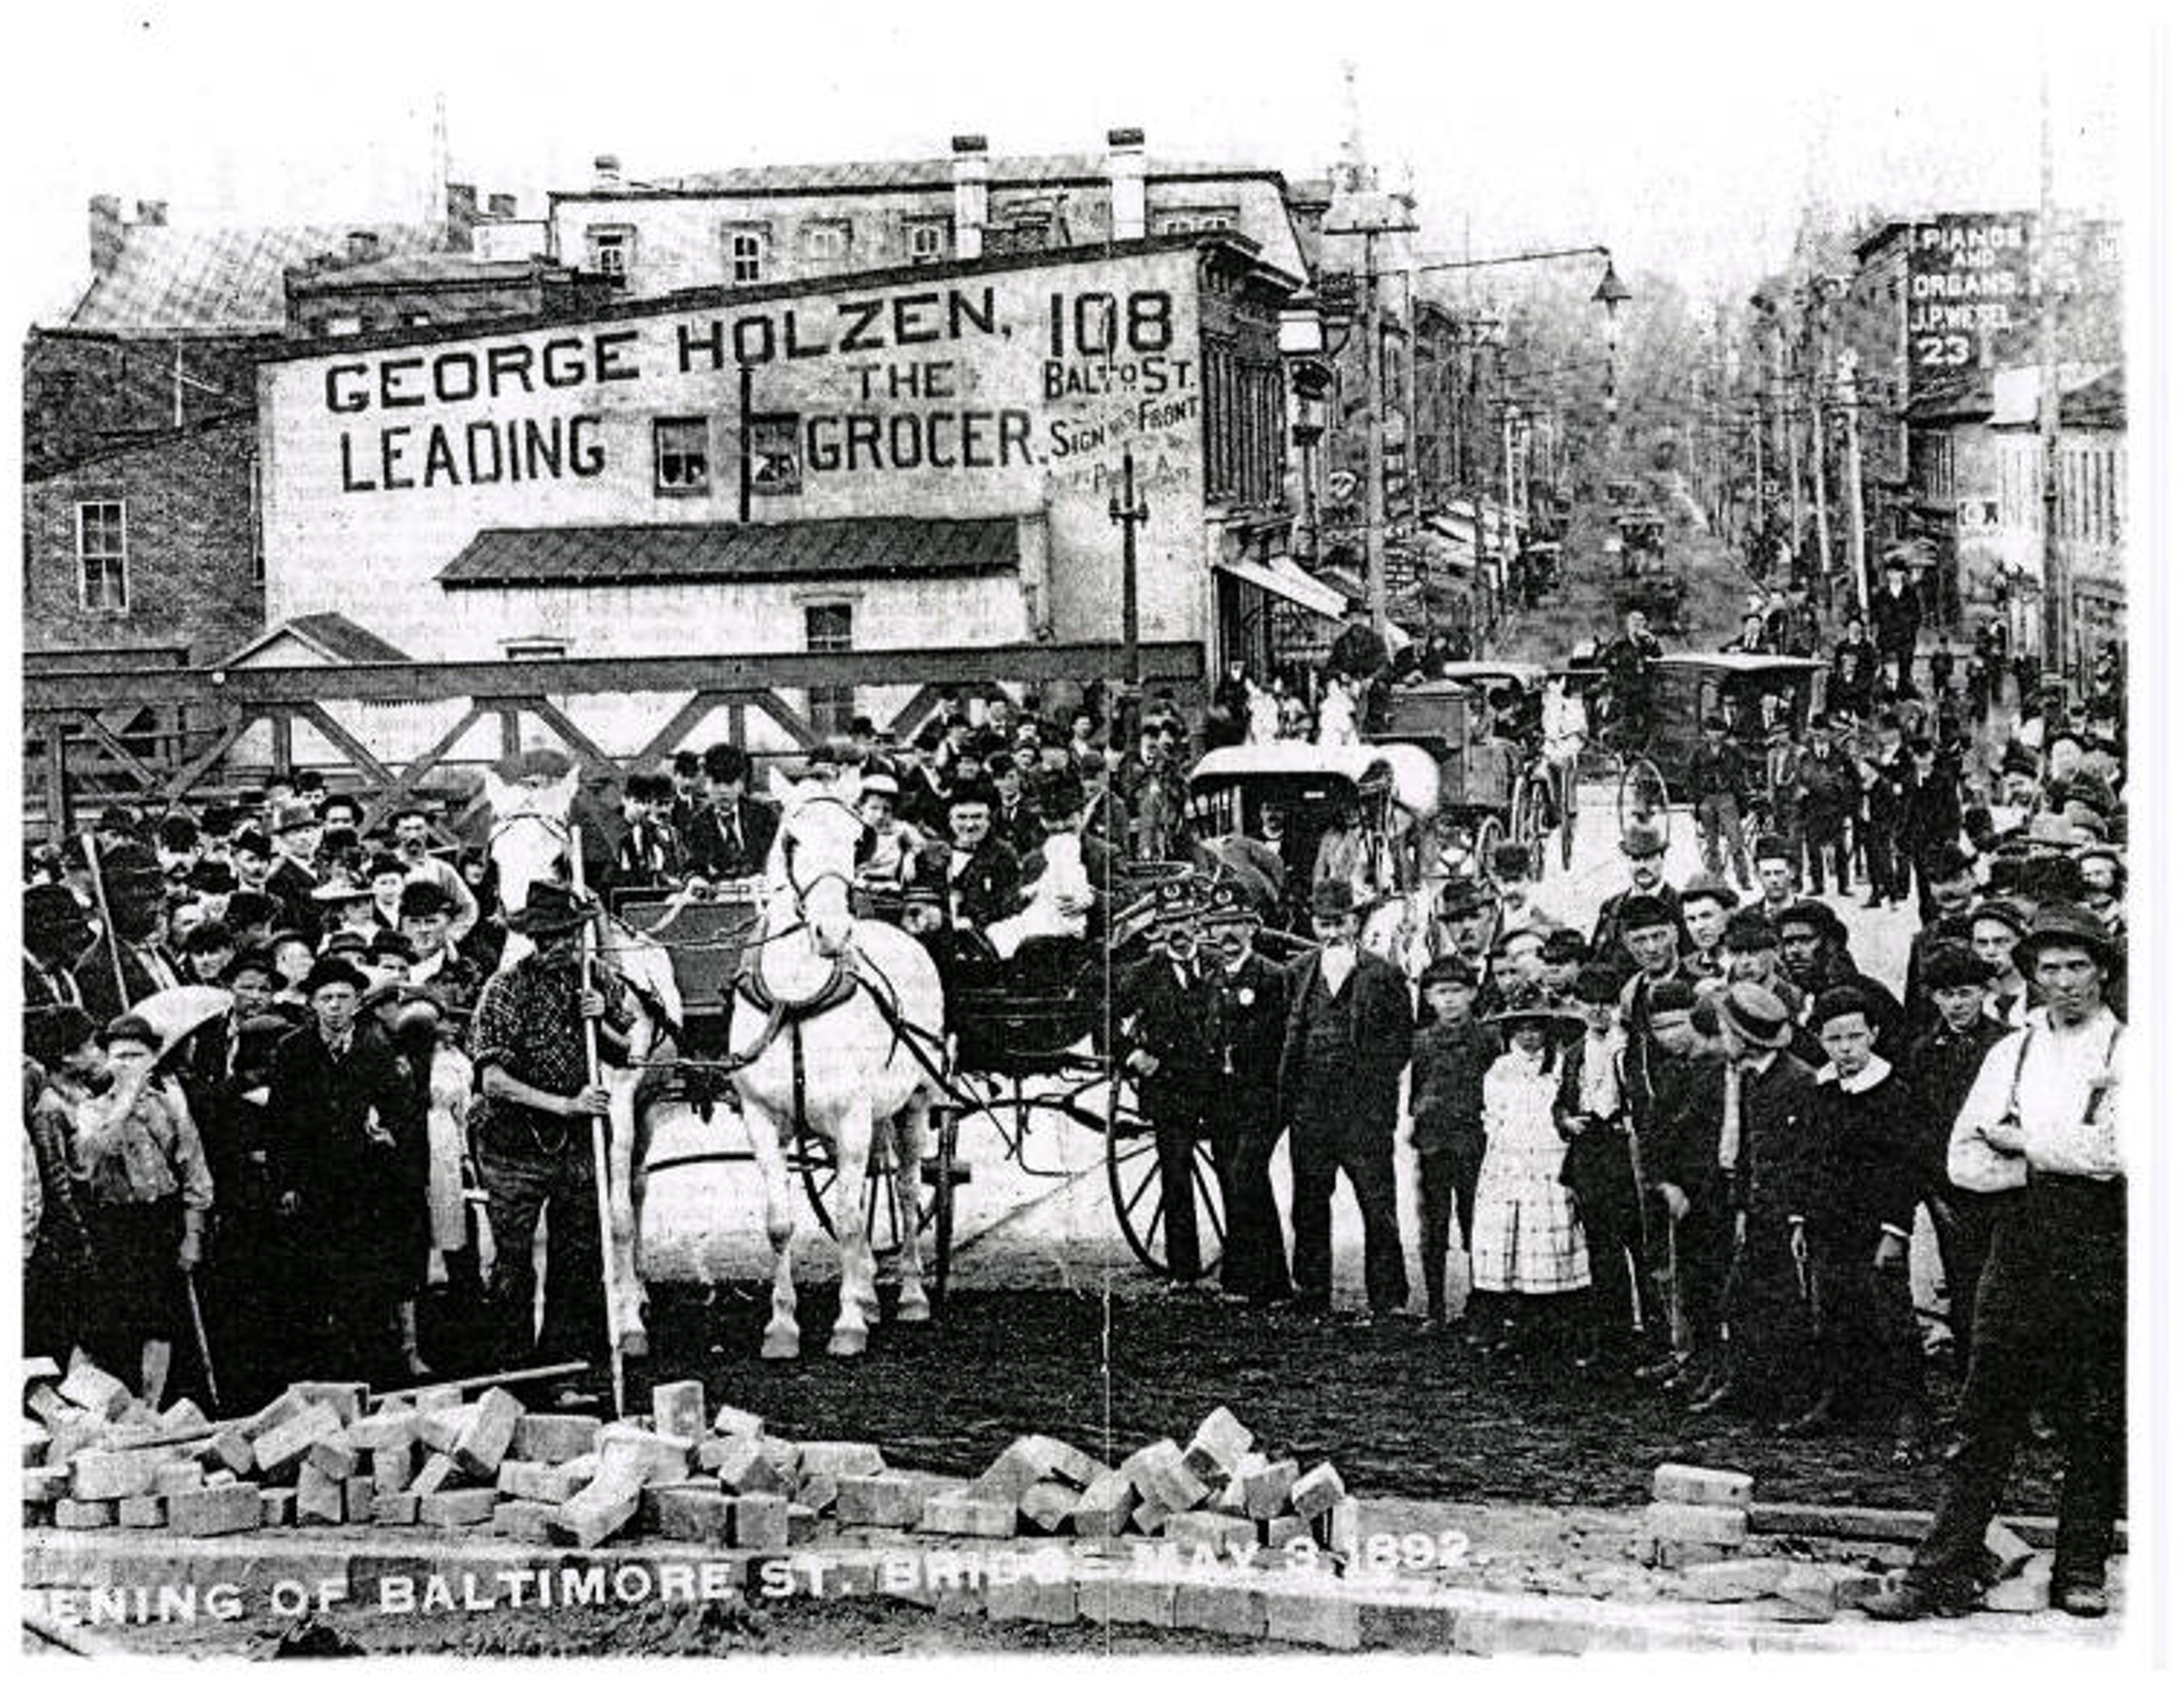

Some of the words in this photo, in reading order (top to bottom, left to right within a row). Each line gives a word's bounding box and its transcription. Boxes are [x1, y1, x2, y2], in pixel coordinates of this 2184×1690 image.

[325, 331, 641, 414] GEORGE
[678, 286, 1012, 374] HOLZEN,
[1050, 290, 1173, 357] 108
[1916, 336, 1970, 366] 23
[847, 360, 954, 401] THE
[341, 414, 607, 493] LEADING
